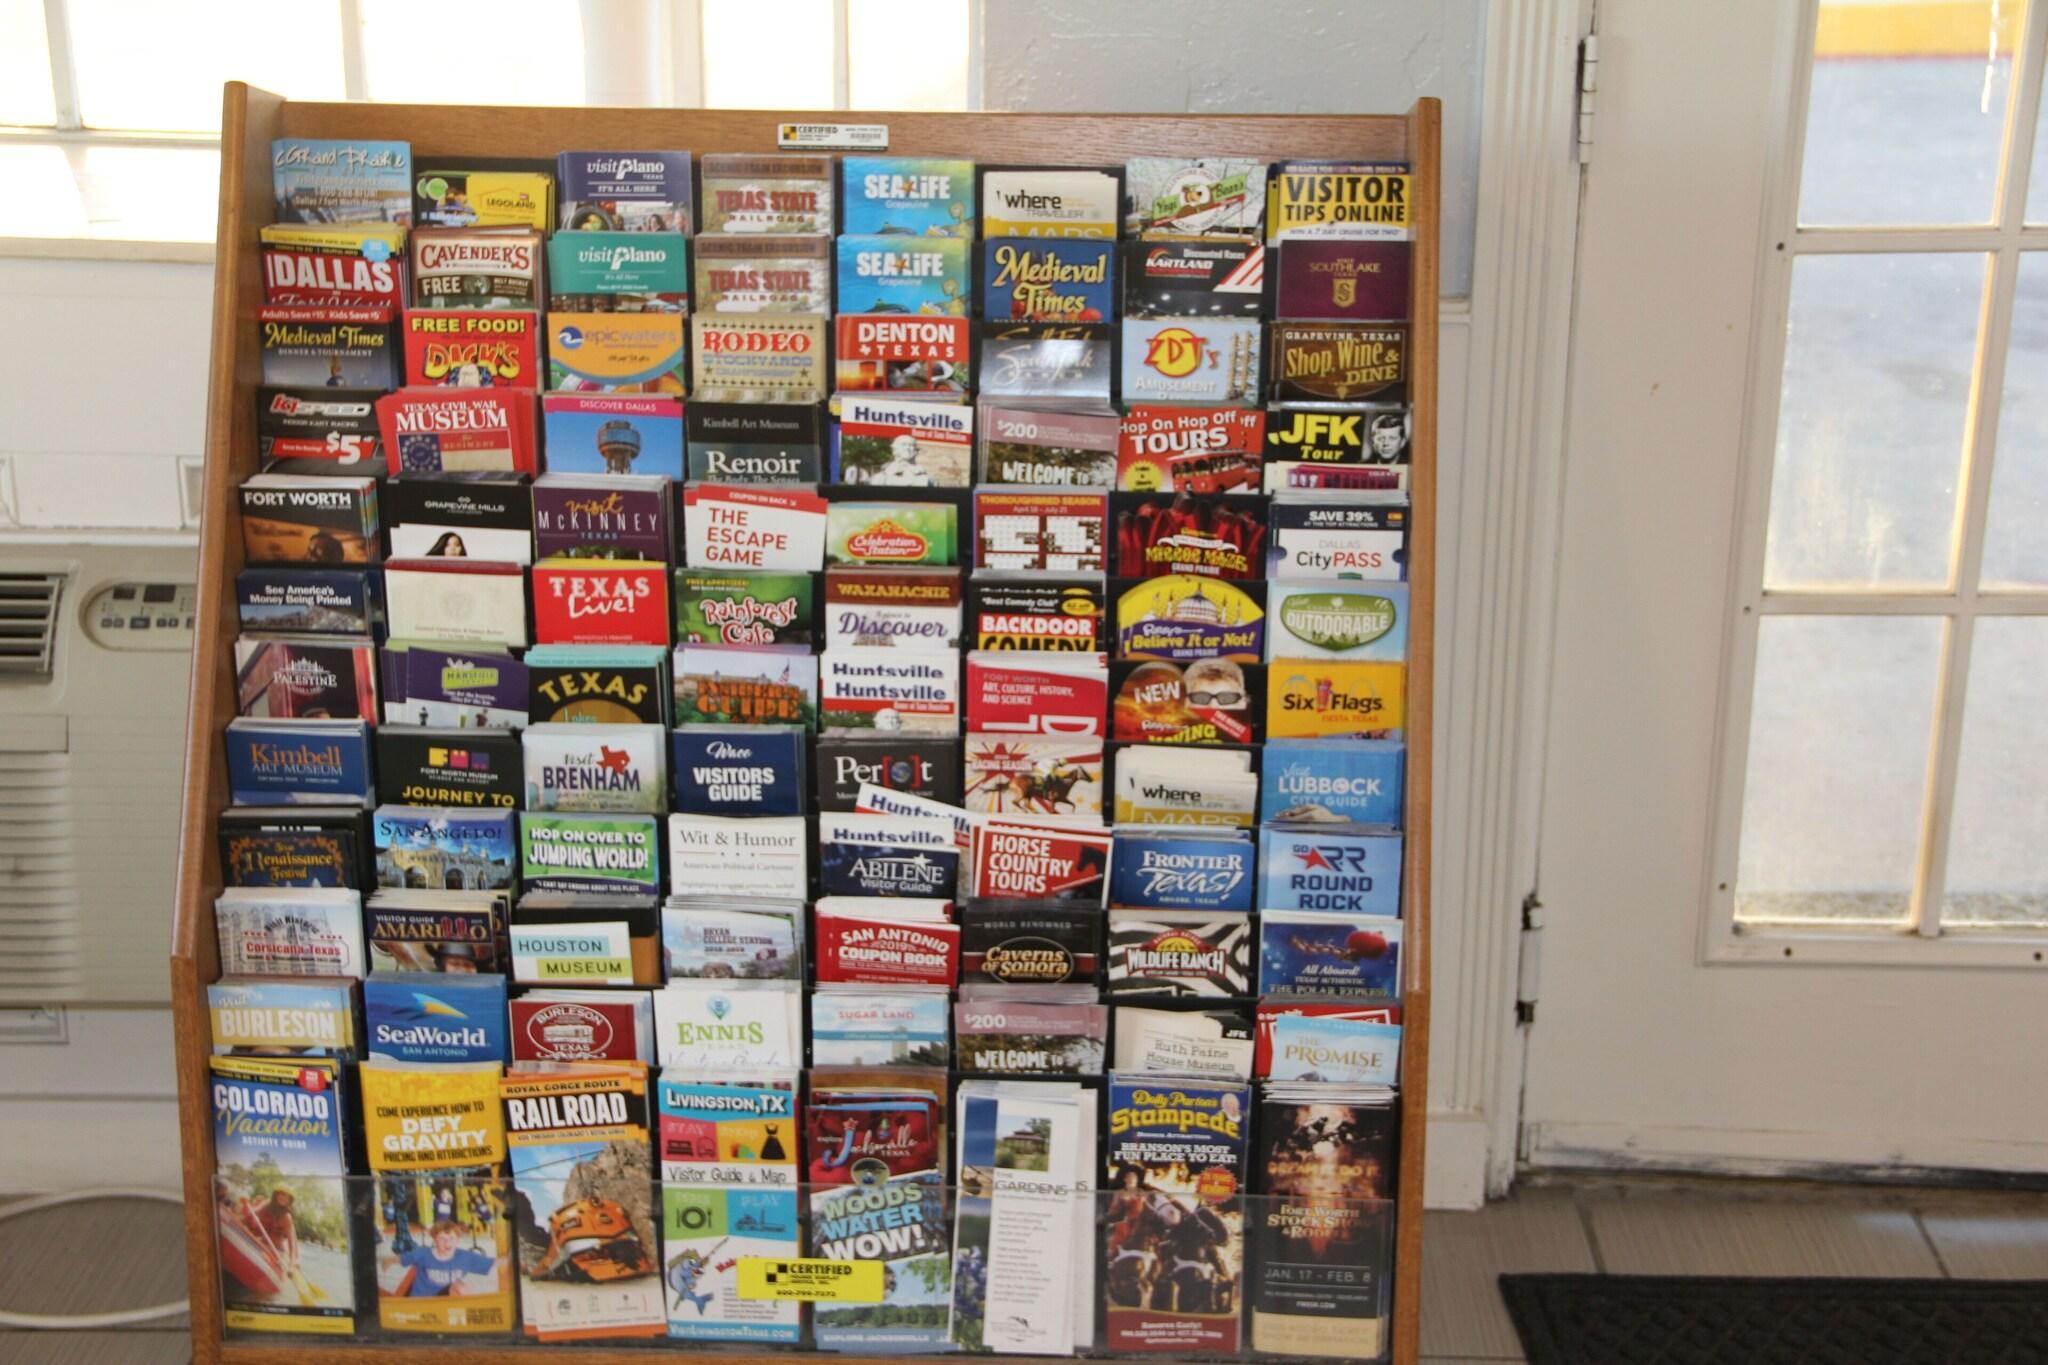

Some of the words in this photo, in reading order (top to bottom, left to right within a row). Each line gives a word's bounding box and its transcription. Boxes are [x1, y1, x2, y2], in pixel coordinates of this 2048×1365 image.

[797, 126, 838, 135] CERTIFIED
[1287, 176, 1404, 203] VISITOR
[1285, 204, 1326, 221] TIPS
[1334, 205, 1404, 222] ONLINE
[993, 246, 1106, 287] Medieval
[1310, 263, 1381, 272] SOUTHLAKE
[422, 277, 462, 296] FREE
[412, 319, 461, 332] FREE
[466, 319, 525, 333] FOOD!
[859, 323, 955, 344] DENTON
[703, 331, 811, 353] RODEO
[1286, 332, 1358, 341] GRAPEVINE,
[1362, 333, 1400, 341] TEXAS
[403, 402, 439, 412] TEXAS
[441, 402, 470, 411] CIVIL
[472, 400, 497, 410] WAR
[580, 400, 623, 411] DISCOVER
[626, 402, 656, 412] DALLAS
[396, 410, 508, 432] MUSEUM
[703, 418, 739, 428] Kimbell
[742, 419, 757, 428] Art
[759, 420, 799, 430] Museum
[854, 406, 964, 430] Huntsville
[1119, 420, 1147, 434] Hop
[1152, 419, 1173, 430] On
[1178, 416, 1208, 428] Hop
[1213, 411, 1237, 425] Off
[1280, 414, 1361, 446] JFK
[1130, 428, 1229, 454] TOURS
[1300, 446, 1343, 460] Tour
[706, 451, 801, 474] Renoir
[244, 492, 292, 506] FORT
[296, 492, 351, 506] WORTH
[425, 501, 476, 511] GRAPEVINE
[478, 504, 504, 512] MILLS
[729, 492, 756, 502] COUPON
[769, 496, 788, 504] BACK
[980, 496, 1058, 505] THOROUGHBRED
[1060, 497, 1101, 506] SEASON
[708, 508, 749, 526] THE
[1309, 511, 1343, 522] SAVE
[1346, 512, 1374, 522] 39%
[581, 532, 618, 540] TEXAS
[706, 527, 788, 551] ESCAPE
[706, 546, 764, 566] GAME
[266, 585, 284, 594] See
[287, 585, 334, 596] America's
[549, 577, 651, 598] TEXAS
[838, 584, 950, 598] WAXAHACHIE
[250, 594, 284, 605] Money
[286, 595, 314, 606] Being
[316, 595, 351, 606] Printed
[568, 589, 634, 619] Live!
[700, 598, 798, 626] Rainforest
[838, 612, 948, 637] Discover
[982, 616, 1092, 635] BACKDOOR
[538, 672, 648, 704] TEXAS
[835, 682, 946, 700] Huntsville
[1134, 681, 1181, 706] NEW
[982, 694, 999, 704] AND
[1001, 694, 1032, 705] SCIENCE
[1283, 692, 1314, 710] Six
[1331, 694, 1382, 714] Flags
[1322, 714, 1350, 722] FIESTA
[1352, 714, 1378, 722] TEXAS
[251, 745, 341, 766] Kimbell
[252, 764, 281, 774] ART
[284, 764, 343, 776] MUSEUM
[420, 767, 440, 776] FORT
[441, 769, 466, 778] WORTH
[468, 771, 498, 781] MUSEUM
[543, 766, 641, 792] BRENHAM
[693, 767, 775, 785] VISITORS
[402, 785, 485, 805] JOURNEY
[493, 794, 514, 807] TO
[708, 785, 762, 802] GUIDE
[1278, 778, 1381, 796] LUBBOCK
[1290, 796, 1320, 806] CITY
[1326, 797, 1368, 807] GUIDE
[530, 829, 559, 842] HOP
[563, 830, 584, 842] ON
[586, 831, 623, 844] OVER
[626, 832, 645, 845] TO
[680, 830, 709, 845] Wit
[714, 832, 728, 845] &
[734, 832, 796, 848] Humor
[992, 835, 1052, 856] HORSE
[529, 846, 592, 868] JUMPING
[594, 848, 648, 869] WORLD!
[1293, 844, 1308, 853] GO
[988, 852, 1073, 877] COUNTRY
[1142, 851, 1243, 870] FRONTIER
[848, 858, 944, 885] ABILENE
[860, 878, 896, 890] Visitor
[899, 880, 933, 893] Guide
[988, 871, 1046, 893] TOURS
[1136, 868, 1244, 900] Texas!
[1291, 874, 1373, 892] ROUND
[1299, 894, 1362, 910] ROCK
[376, 915, 406, 923] VISITOR
[408, 916, 435, 924] GUIDE
[984, 921, 1015, 929] WORLD
[518, 938, 602, 953] HOUSTON
[841, 928, 874, 944] SAN
[878, 928, 950, 952] ANTONIO
[880, 940, 907, 950] 2019
[838, 946, 901, 964] COUPON
[904, 948, 948, 967] BOOK
[985, 947, 1065, 962] Caverns
[546, 962, 622, 974] MUSEUM
[1302, 964, 1318, 975] All
[1320, 965, 1360, 976] Aboard!
[220, 1009, 336, 1040] BURLESON
[535, 1007, 603, 1026] BURLESON
[838, 1011, 878, 1019] SUGAR
[882, 1011, 914, 1020] LAND
[964, 1013, 1006, 1028] $200
[376, 1025, 486, 1048] SeaWorld
[676, 1022, 764, 1045] ENNIS
[1226, 1029, 1247, 1038] JFK
[402, 1046, 421, 1055] SAN
[424, 1047, 468, 1056] ANTONIO
[552, 1043, 590, 1052] TEXAS
[1284, 1045, 1383, 1068] PROMISE
[1146, 1051, 1182, 1066] House
[1187, 1057, 1235, 1071] Museum
[506, 1085, 540, 1094] ROYAL
[544, 1082, 581, 1090] GORGE
[584, 1080, 620, 1088] ROUTE
[214, 1084, 329, 1119] COLORADO
[508, 1092, 628, 1131] RAILROAD
[217, 1108, 330, 1136] Vacation
[402, 1116, 463, 1134] DEFY
[1111, 1106, 1240, 1137] Stampede
[384, 1130, 487, 1152] GRAVITY
[1121, 1142, 1192, 1152] BRANSON'S
[1194, 1144, 1231, 1154] MOST
[1114, 1152, 1135, 1161] FUN
[1137, 1152, 1185, 1162] PLACE
[1188, 1153, 1204, 1162] TO
[1207, 1154, 1236, 1163] EAT!
[994, 1180, 1068, 1195] GARDENS
[823, 1183, 923, 1220] WOODS
[1280, 1206, 1310, 1216] FORT
[1316, 1207, 1360, 1218] WORTH
[821, 1204, 923, 1240] WATER
[821, 1224, 924, 1260] WOW!
[789, 1263, 853, 1277] CERTIFIED
